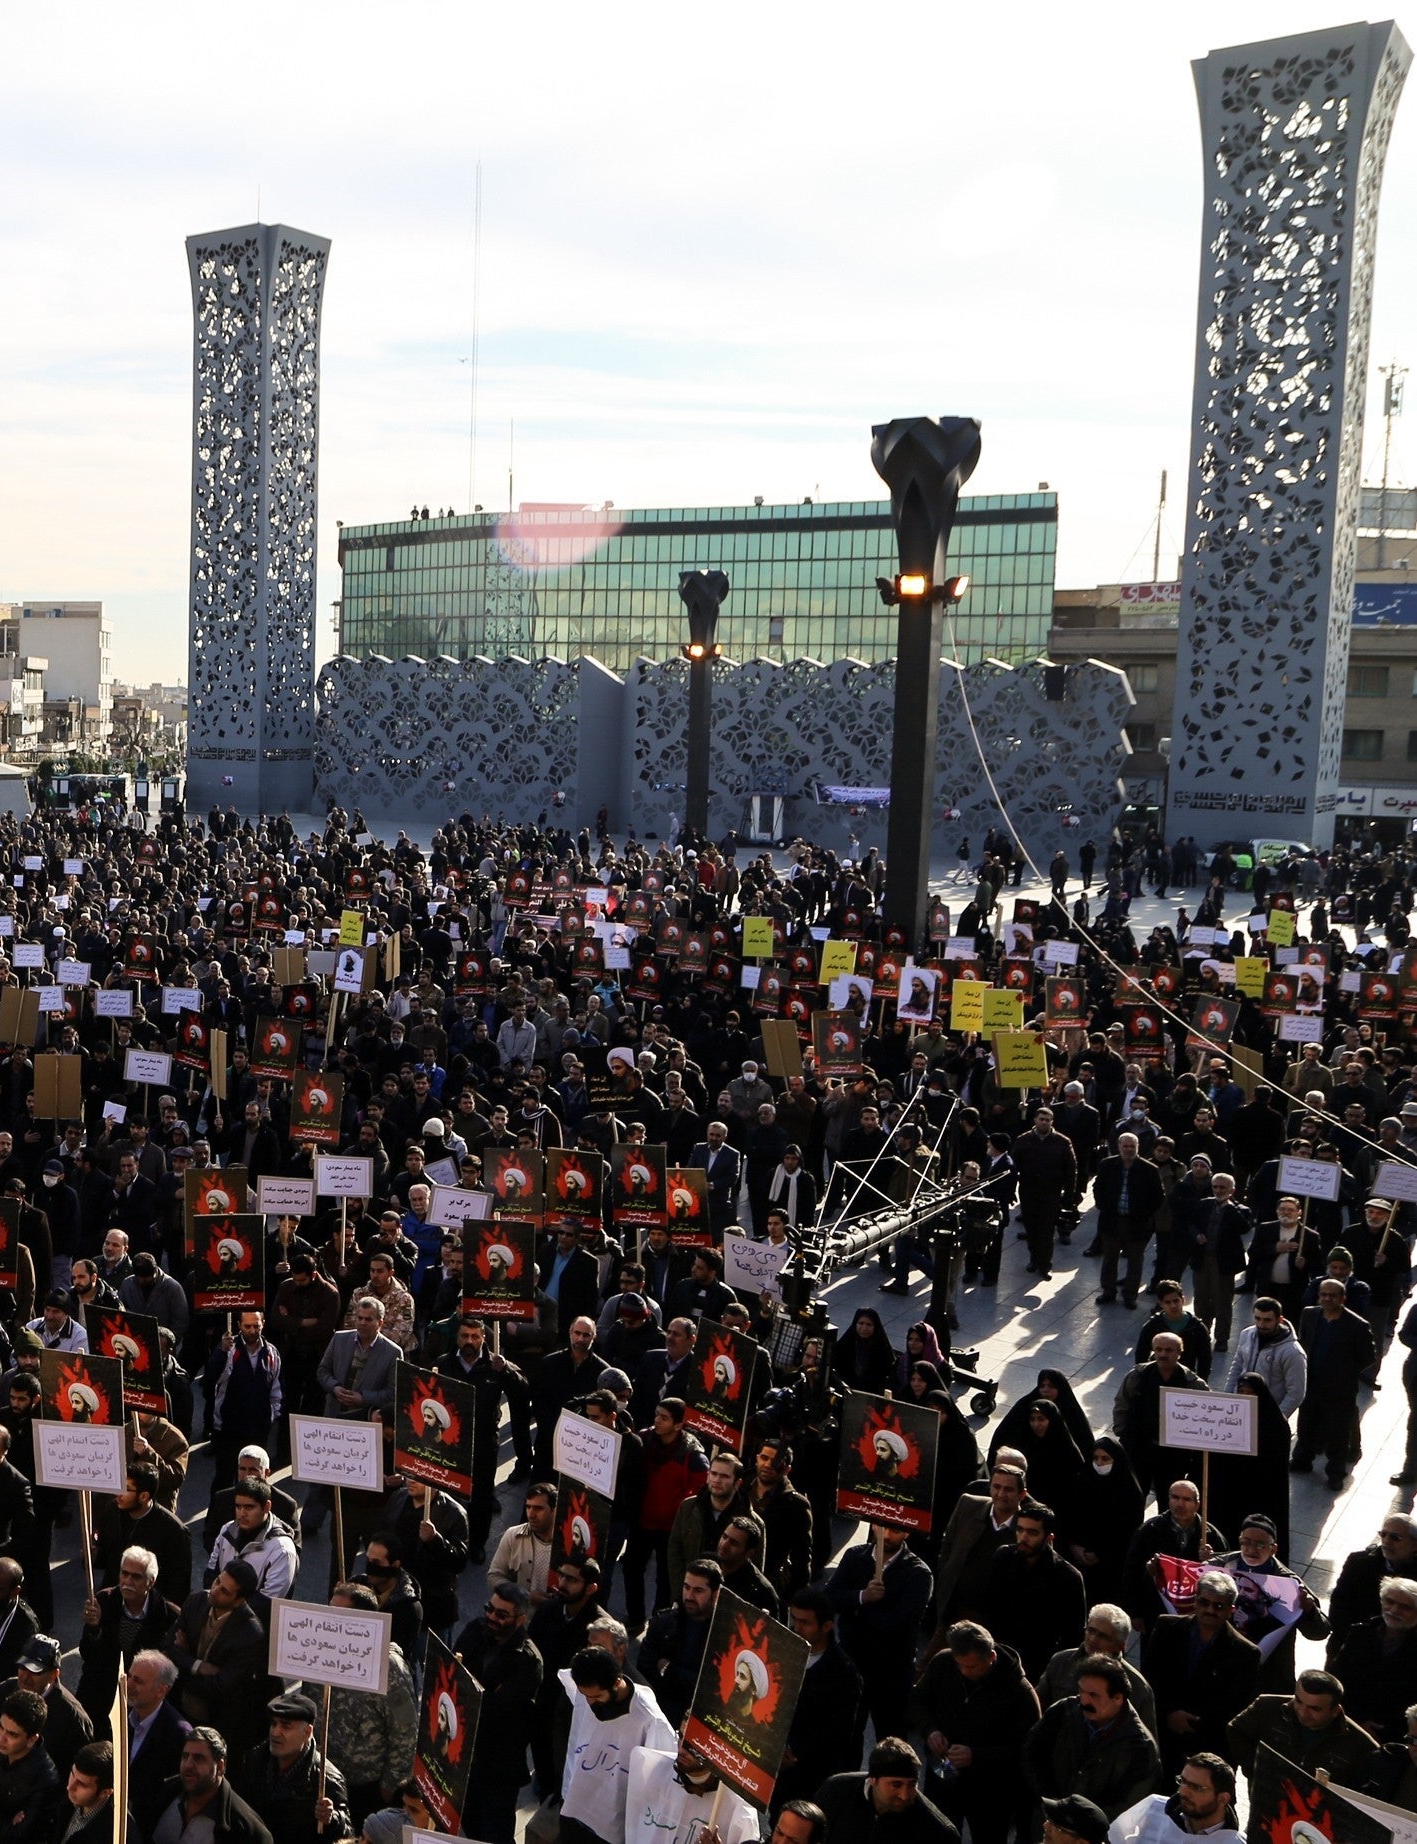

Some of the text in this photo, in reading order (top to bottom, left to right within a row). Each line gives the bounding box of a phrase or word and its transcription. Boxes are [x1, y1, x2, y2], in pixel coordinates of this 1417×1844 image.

[456, 1200, 471, 1208] مرگ
[444, 1212, 460, 1220] سعود
[1174, 1399, 1239, 1415] آل سعود خبیث
[1172, 1411, 1242, 1427] انتقام سخت خدا
[47, 1434, 110, 1446] دست انتقام الهی
[303, 1429, 367, 1444] دست انتقام الهی
[1179, 1427, 1232, 1443] در راه است.
[48, 1448, 113, 1464] گریبان سعودی ها
[303, 1441, 369, 1461] گریبان سعودی ها
[50, 1464, 113, 1479] را خواهد گرفت.
[305, 1457, 367, 1477] را خواهد گرفت.
[289, 1617, 371, 1639] دست انتقام الهی
[287, 1631, 372, 1658] گریبان سعودی ها
[286, 1651, 367, 1677] را خواهد گرفت.
